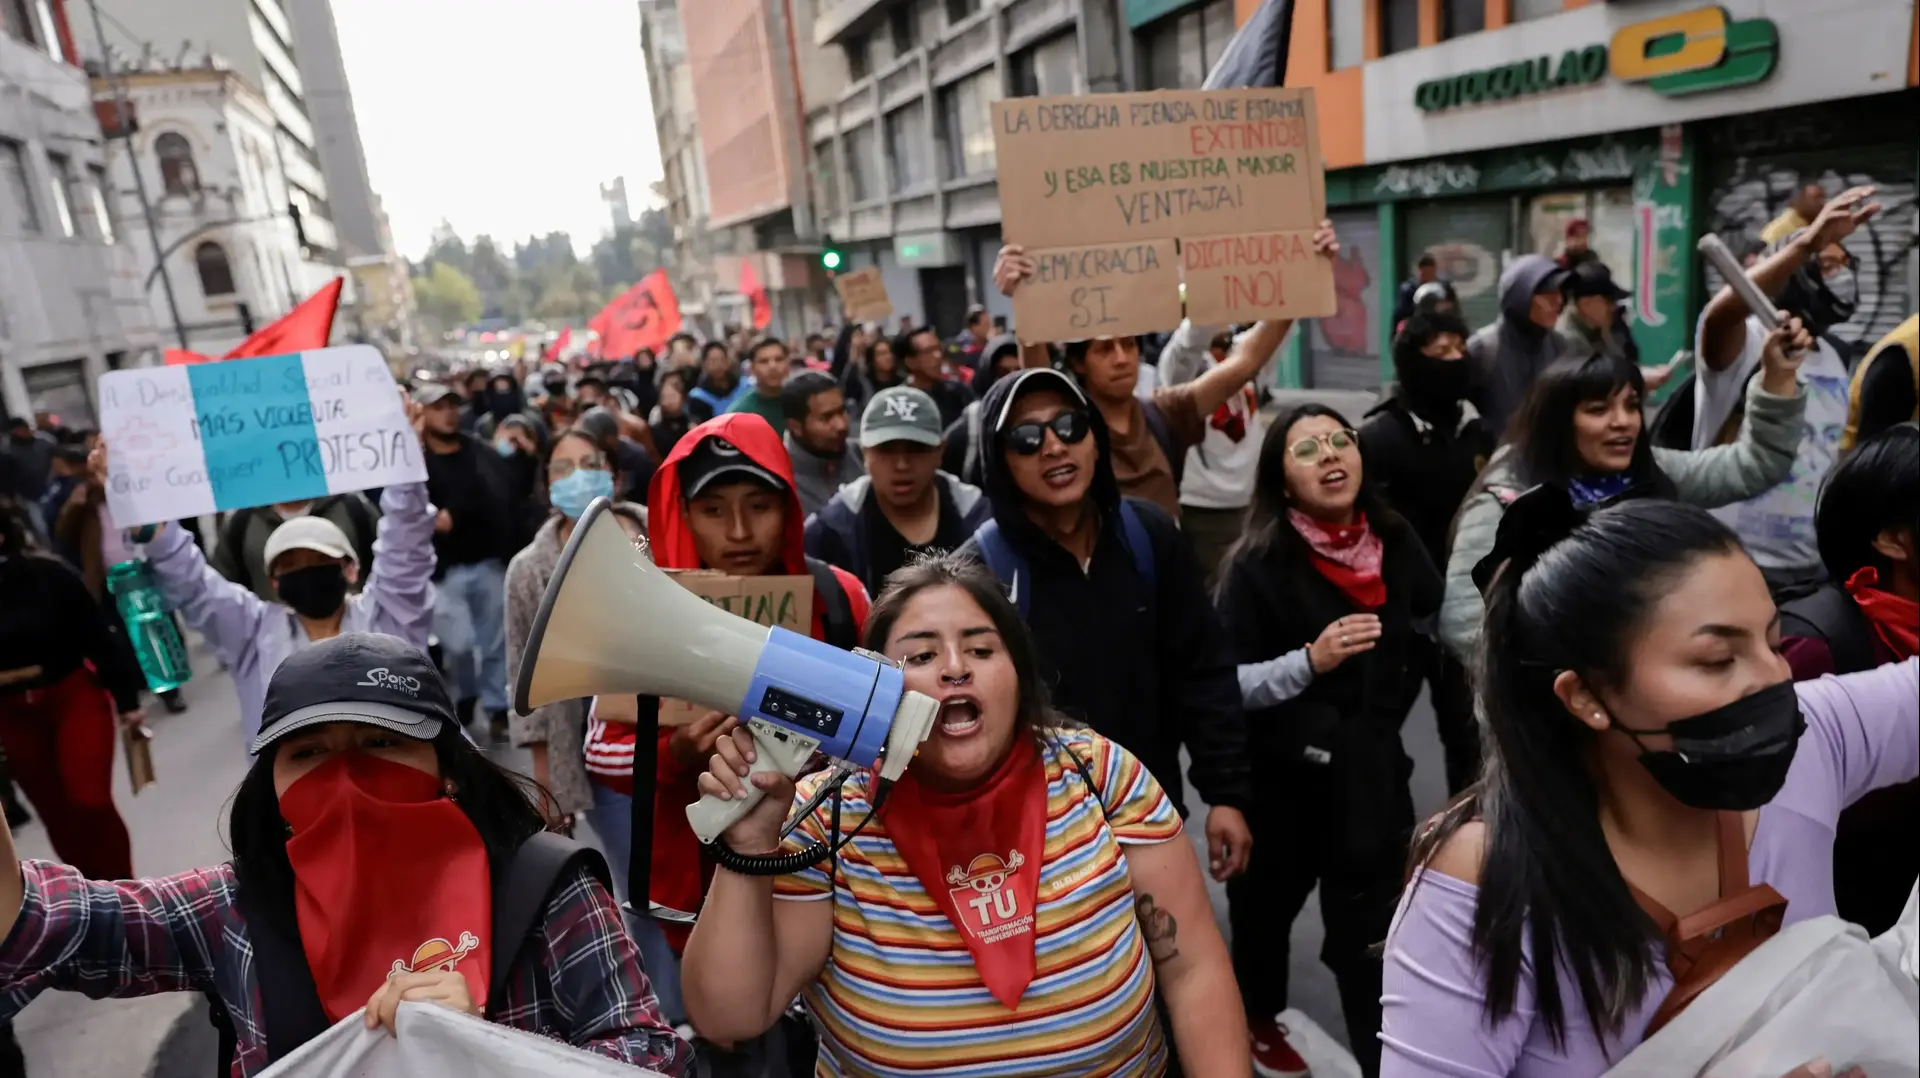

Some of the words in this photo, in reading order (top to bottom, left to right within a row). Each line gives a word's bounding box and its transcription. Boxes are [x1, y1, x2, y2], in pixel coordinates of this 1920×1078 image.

[1414, 45, 1607, 111] COTOCOLLAO
[1004, 109, 1031, 134] LA
[1037, 102, 1120, 132] DERECHA
[1130, 101, 1197, 127] PIENSA
[1203, 98, 1237, 121] QUE
[1065, 165, 1105, 194] ESA
[1109, 160, 1131, 186] ES
[1140, 156, 1230, 182] NUESTRA
[1236, 152, 1296, 178] MAYOR
[1184, 232, 1309, 272] DICTADURA
[1068, 285, 1119, 328] SI
[105, 385, 119, 409] A
[884, 396, 919, 421] NY
[277, 428, 413, 480] PROTESTA
[381, 683, 419, 698] FASHION
[969, 888, 1018, 925] TU
[977, 914, 1034, 939] TRANSFORMACIÓN
[984, 925, 1031, 945] UNIVERSITARIA
